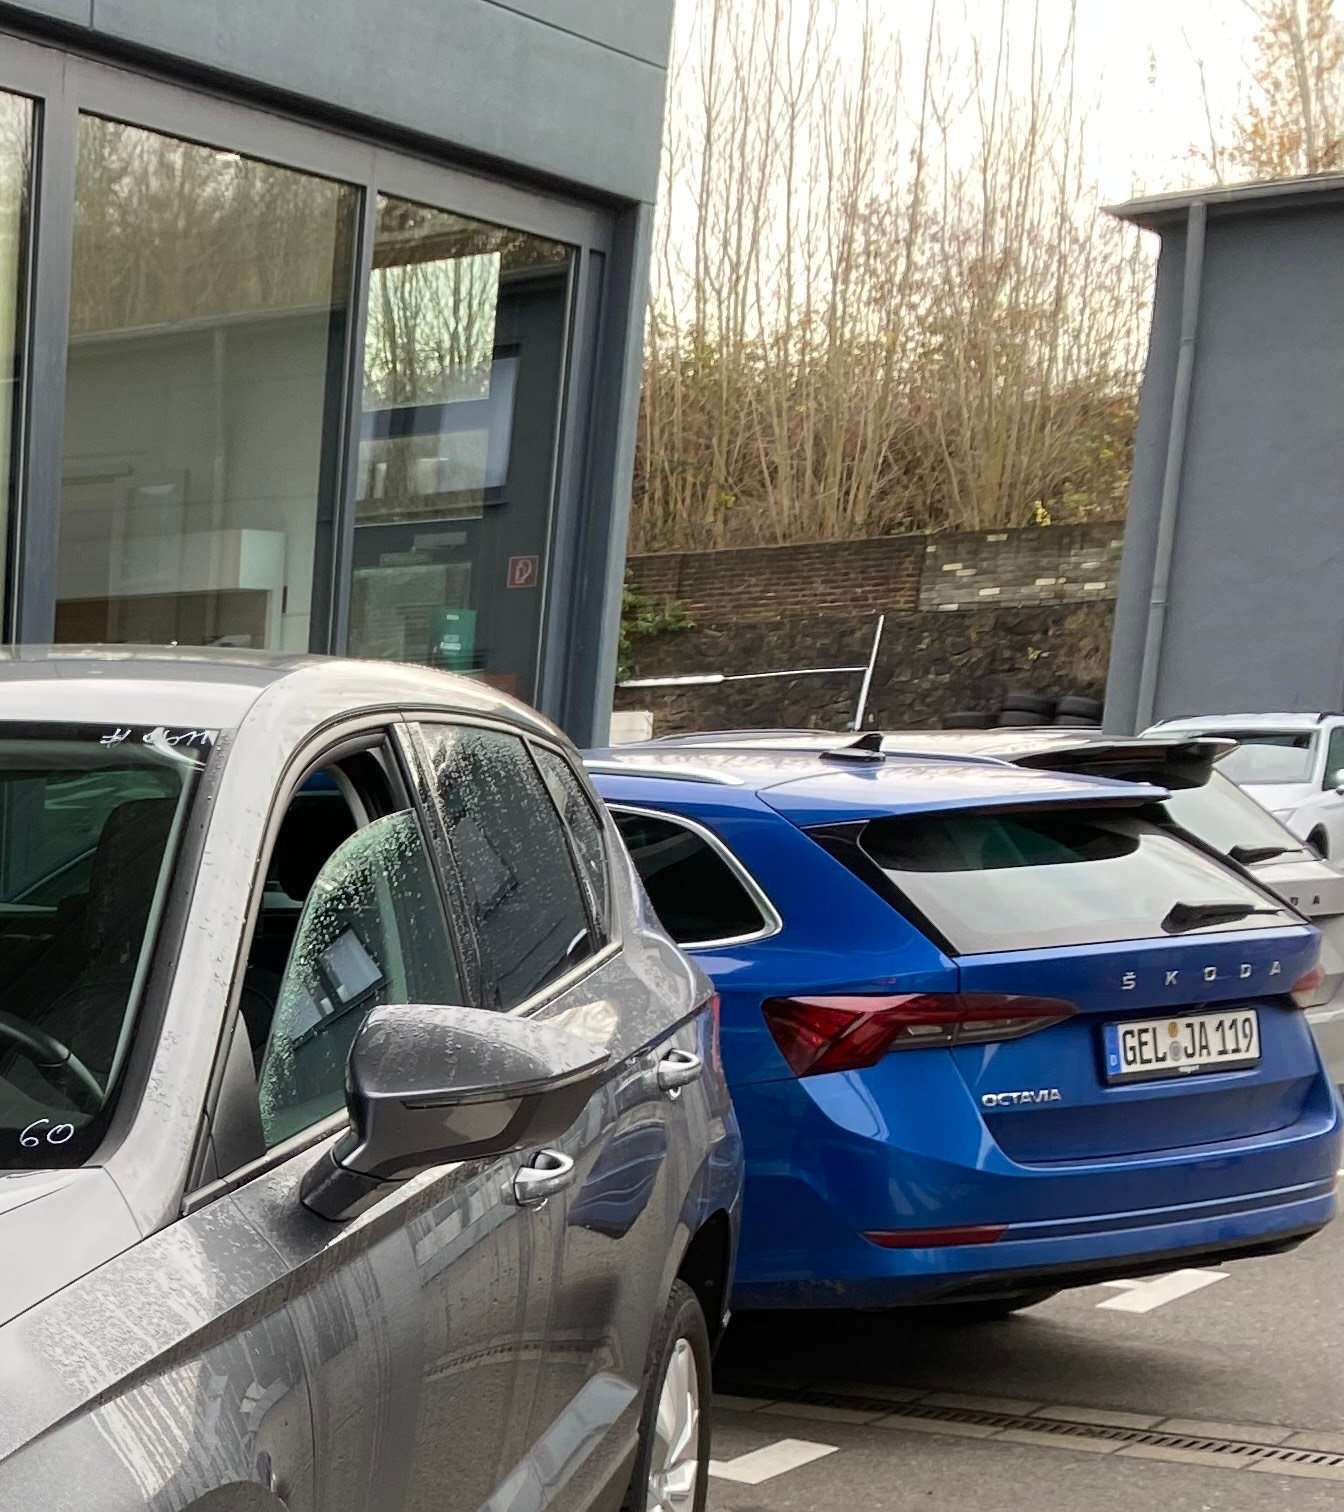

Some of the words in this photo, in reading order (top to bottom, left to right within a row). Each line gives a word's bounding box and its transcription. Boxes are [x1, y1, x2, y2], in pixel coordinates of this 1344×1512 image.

[1120, 960, 1281, 990] ŠKODA
[1122, 1026, 1167, 1066] GEL
[1183, 1021, 1211, 1058] JA
[1215, 1017, 1254, 1056] 119
[981, 1088, 1062, 1107] OCTAVIA
